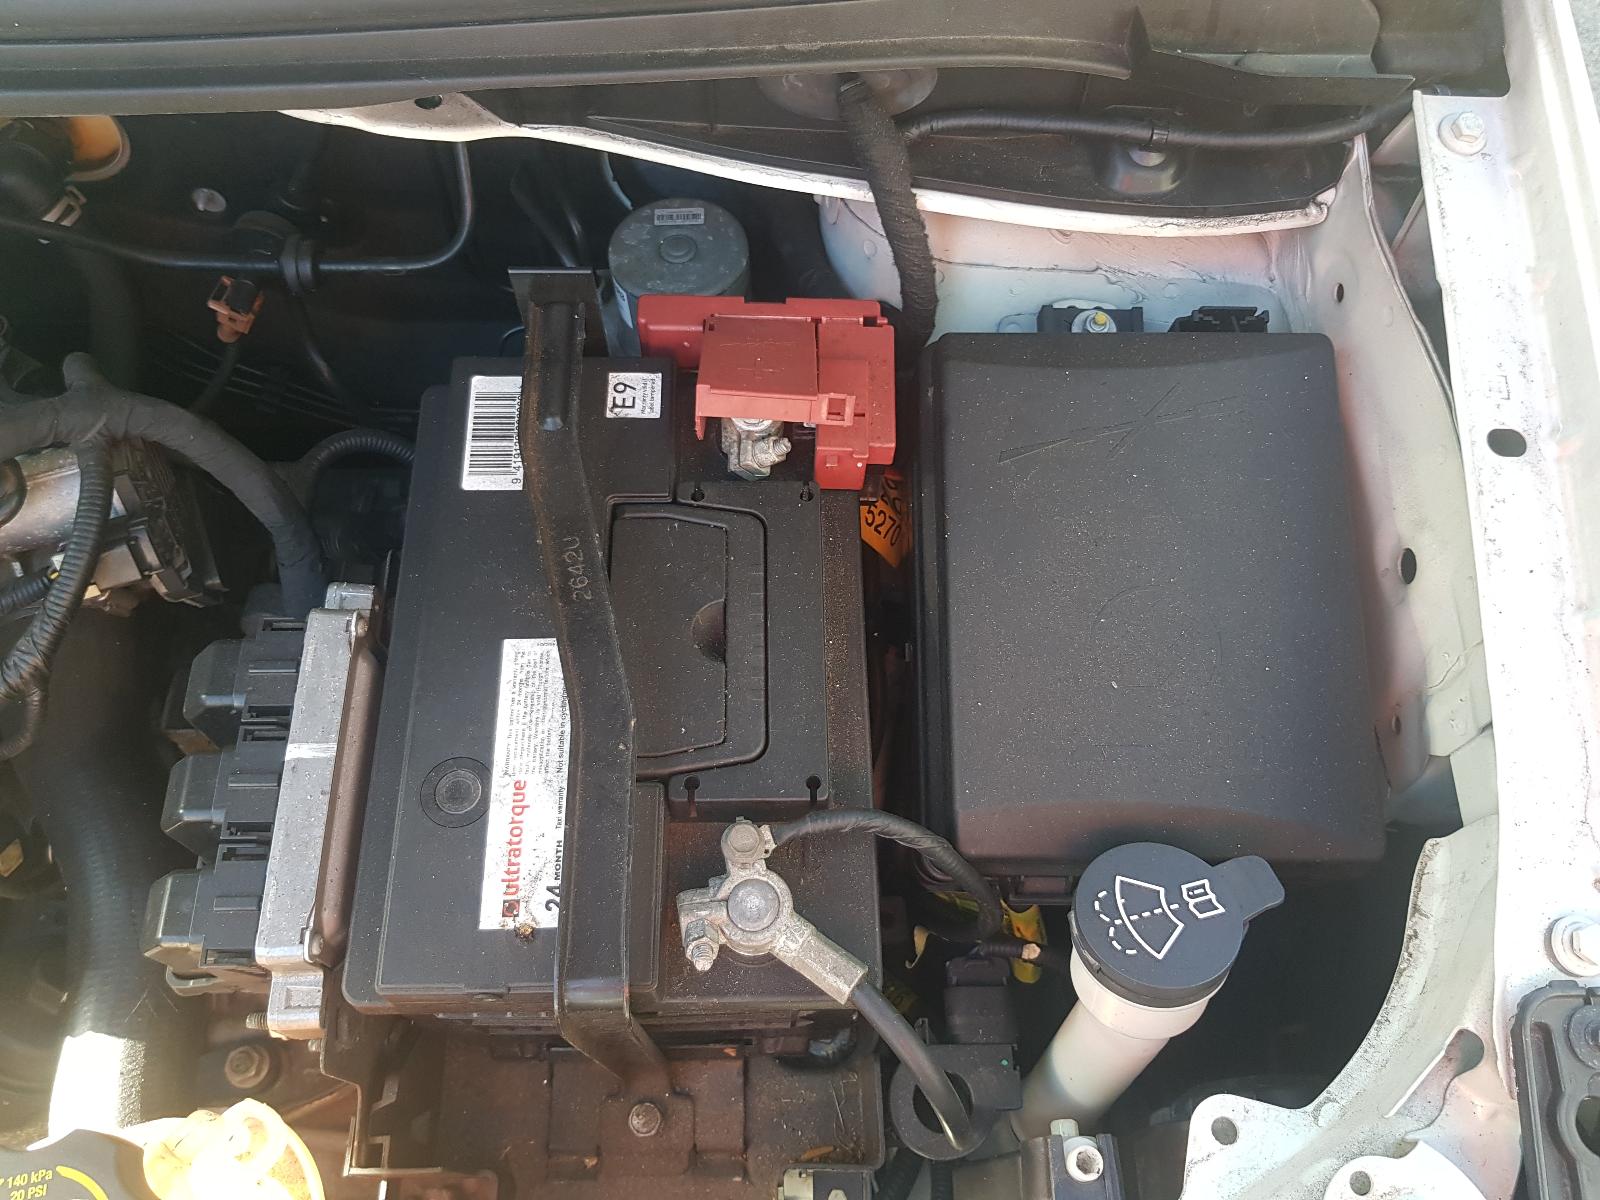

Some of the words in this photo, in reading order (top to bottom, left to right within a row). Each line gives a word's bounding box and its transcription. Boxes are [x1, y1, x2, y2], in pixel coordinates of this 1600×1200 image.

[612, 382, 637, 409] E9
[865, 503, 902, 546] 5270
[557, 730, 566, 758] suitable
[556, 760, 564, 773] Not
[501, 779, 530, 896] ultratorque
[554, 840, 562, 880] MONTH
[6, 1173, 28, 1188] 140
[30, 1168, 53, 1184] kPa
[9, 1189, 26, 1200] 20
[27, 1184, 48, 1199] PSI
